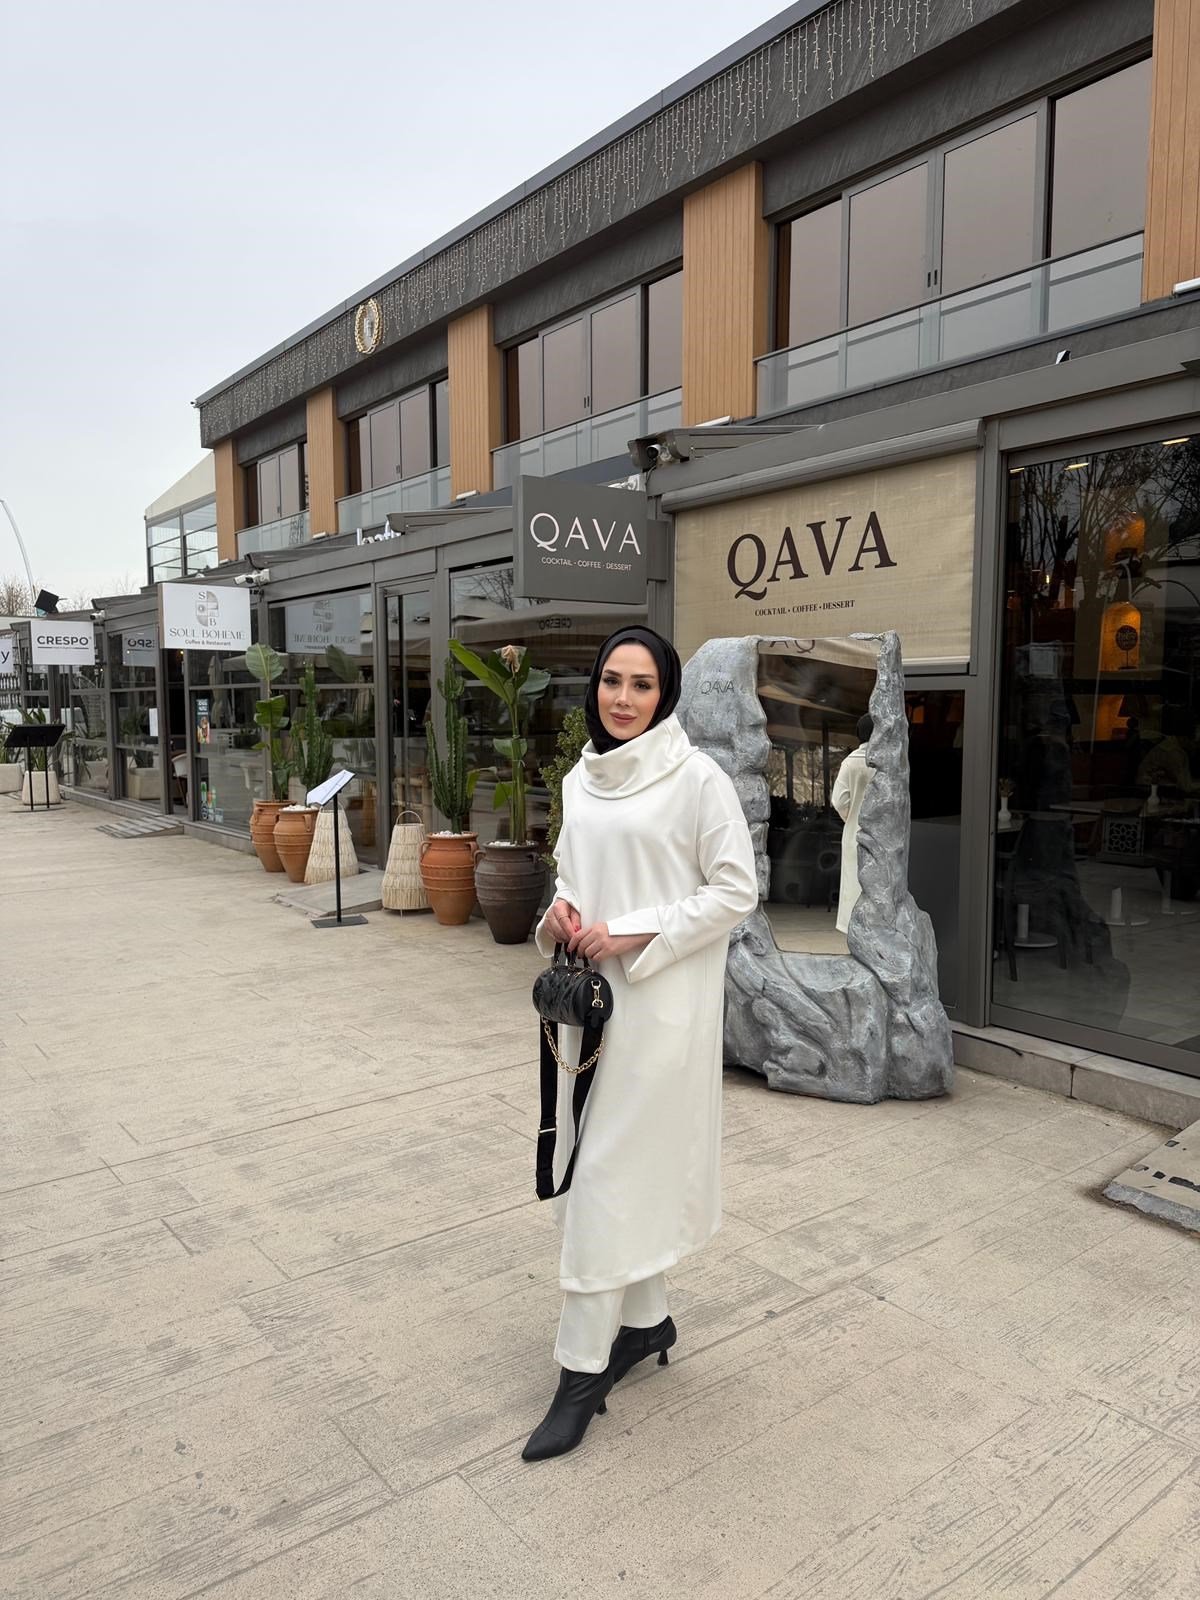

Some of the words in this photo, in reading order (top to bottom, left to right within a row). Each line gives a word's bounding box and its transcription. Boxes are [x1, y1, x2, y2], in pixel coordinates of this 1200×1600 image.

[530, 512, 641, 555] QAVA
[727, 511, 897, 601] QAVA
[541, 557, 573, 566] COCKTAIL
[577, 560, 602, 569] COFFEE
[606, 562, 632, 571] DESSERT
[755, 607, 787, 616] COCKTAIL
[792, 603, 818, 613] COFFEE
[822, 600, 855, 610] DESSERT
[169, 627, 199, 638] SOUL
[37, 635, 89, 646] CRESPO
[701, 680, 735, 695] QAVA
